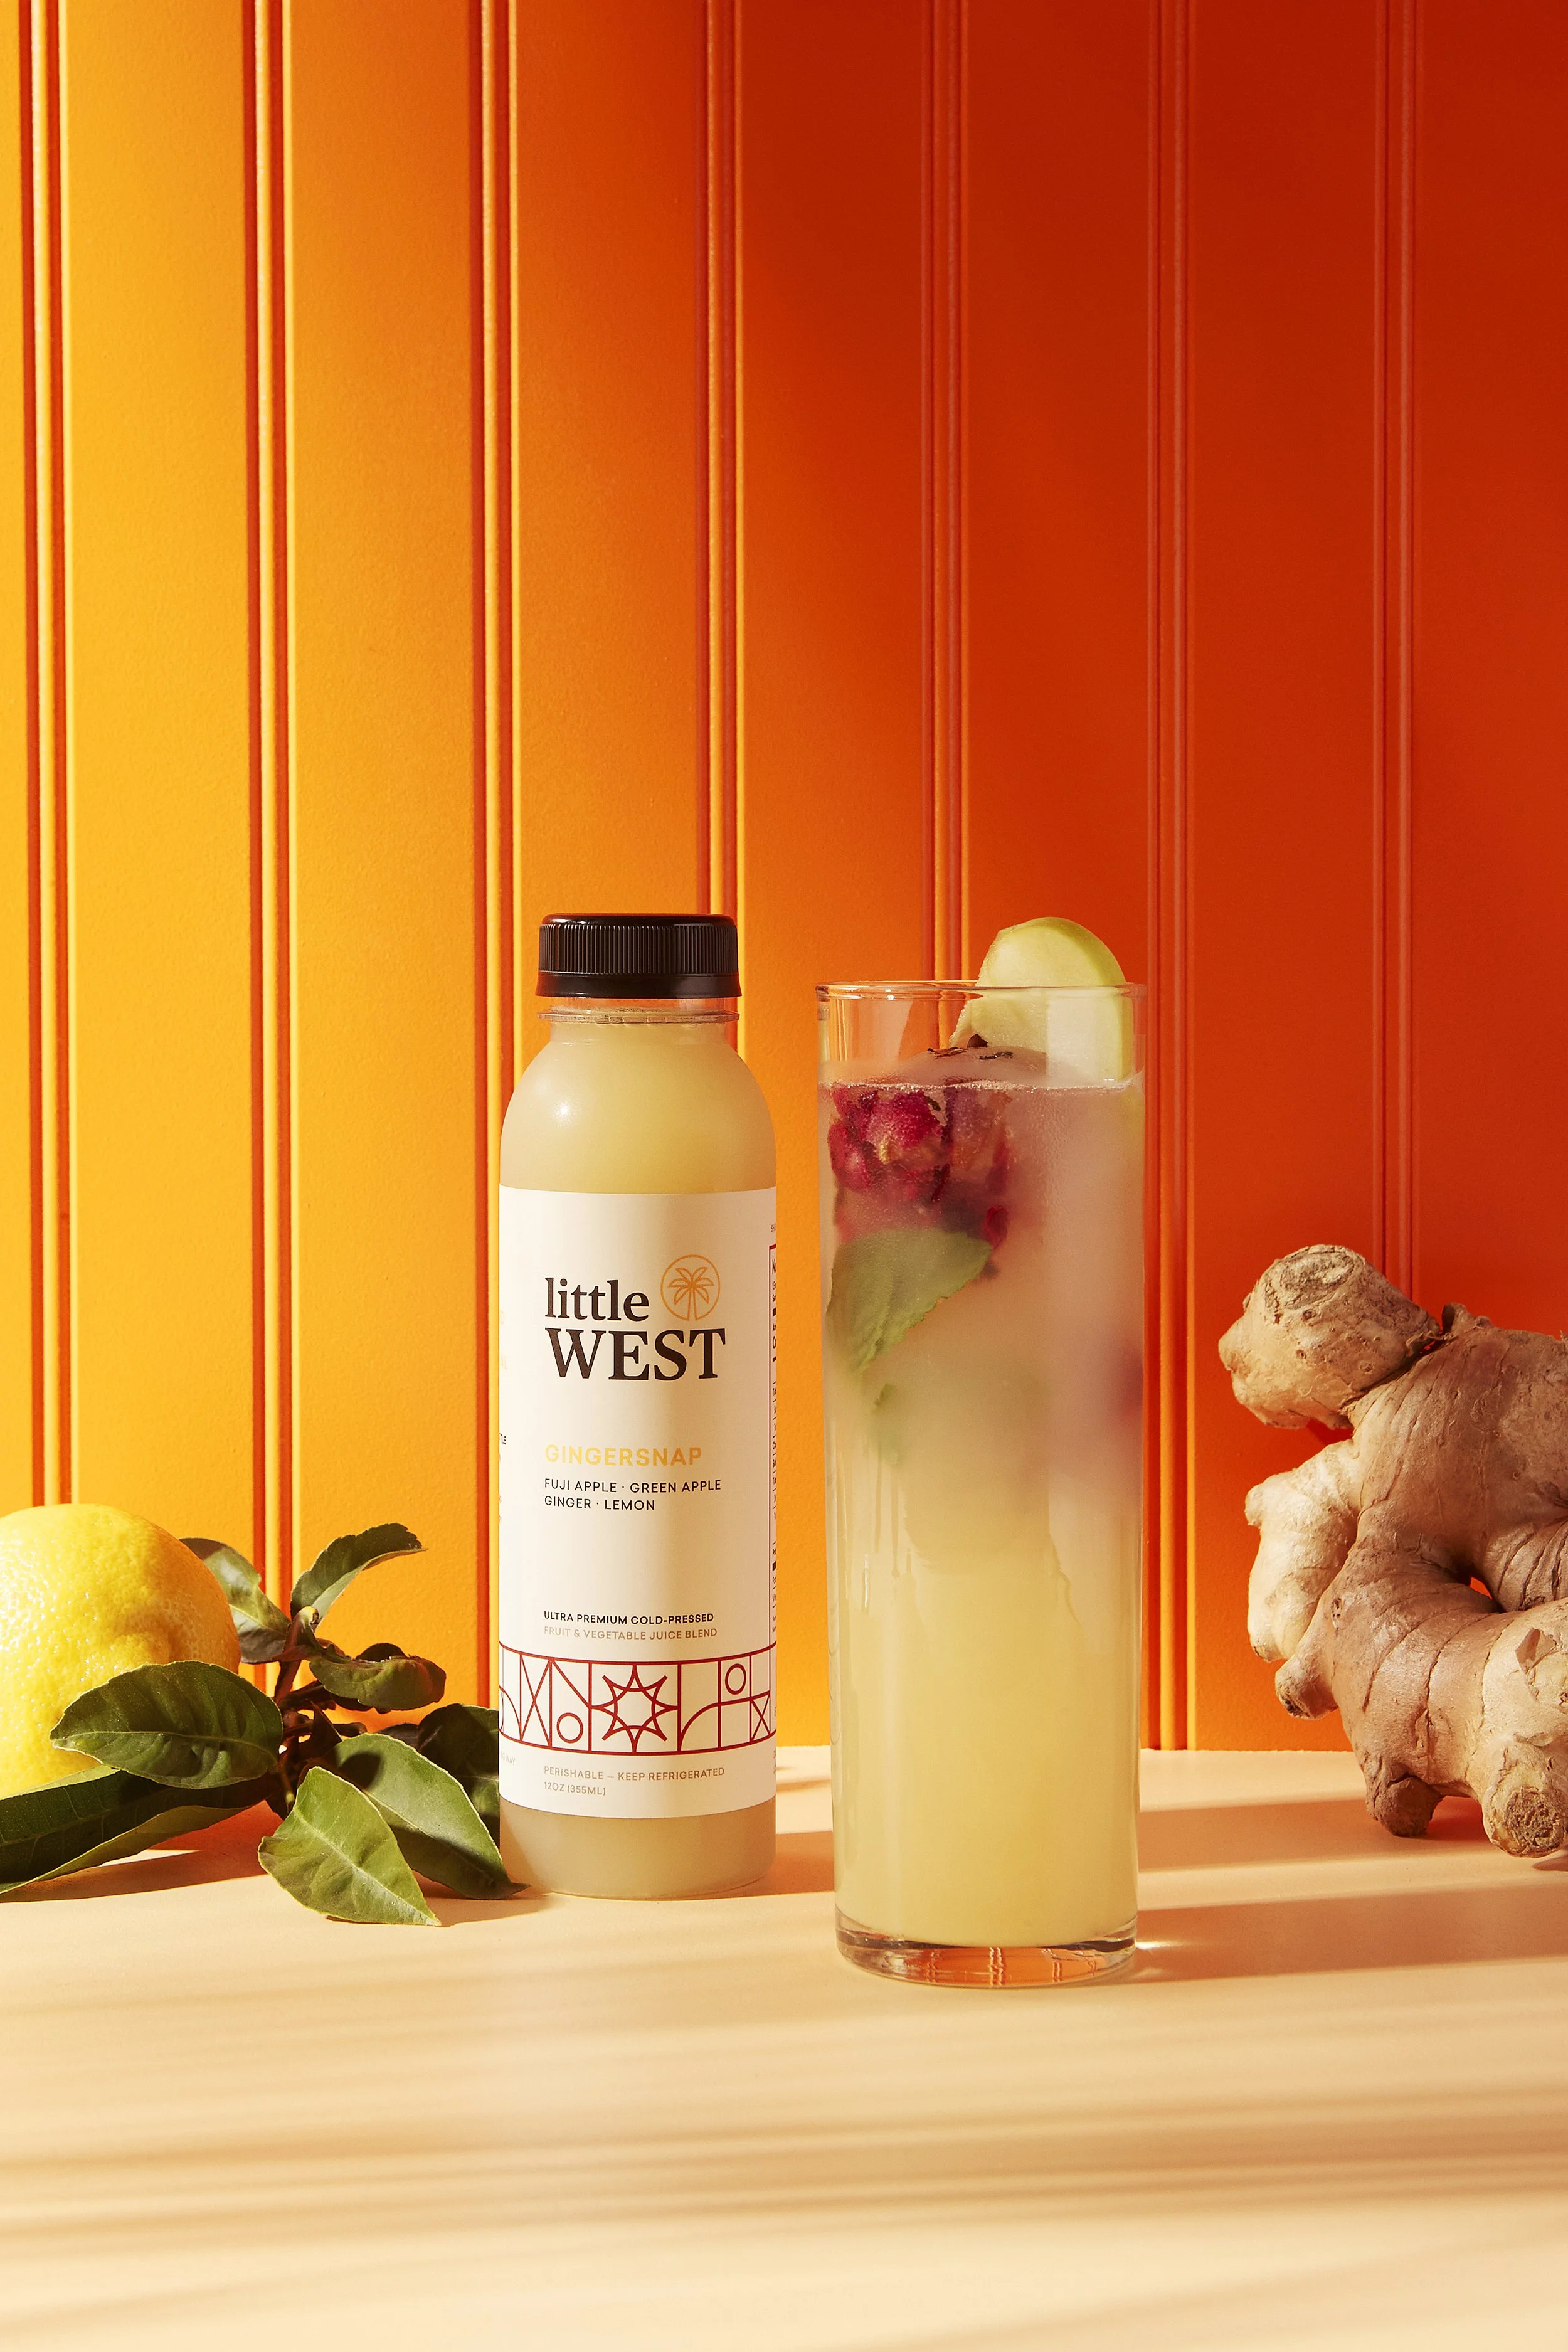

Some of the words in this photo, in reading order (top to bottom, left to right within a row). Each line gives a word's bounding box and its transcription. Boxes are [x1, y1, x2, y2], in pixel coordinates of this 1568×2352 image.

[545, 1278, 649, 1322] little
[545, 1328, 725, 1380] WEST
[546, 1445, 701, 1466] GINGERSNAP
[545, 1478, 569, 1490] FUJI
[575, 1481, 616, 1492] APPLE
[630, 1483, 676, 1493] GREEN
[682, 1480, 721, 1492] APPLE
[545, 1496, 591, 1508] GINGER
[605, 1500, 654, 1510] LEMON
[544, 1611, 573, 1621] ULTRA
[577, 1614, 627, 1624] PREMIUM
[631, 1613, 713, 1624] COLD-PRESSED
[544, 1626, 571, 1636] FRUIT
[583, 1630, 646, 1640] VEGETABLE
[650, 1631, 681, 1640] JUICE
[686, 1628, 717, 1638] BLEND
[506, 1756, 516, 1765] WAY
[544, 1766, 603, 1779] PERISHABLE
[618, 1772, 645, 1781] KEEP
[649, 1767, 724, 1781] REFRIGERATED
[544, 1781, 564, 1791] 12OZ
[568, 1785, 605, 1796] (355ML)
